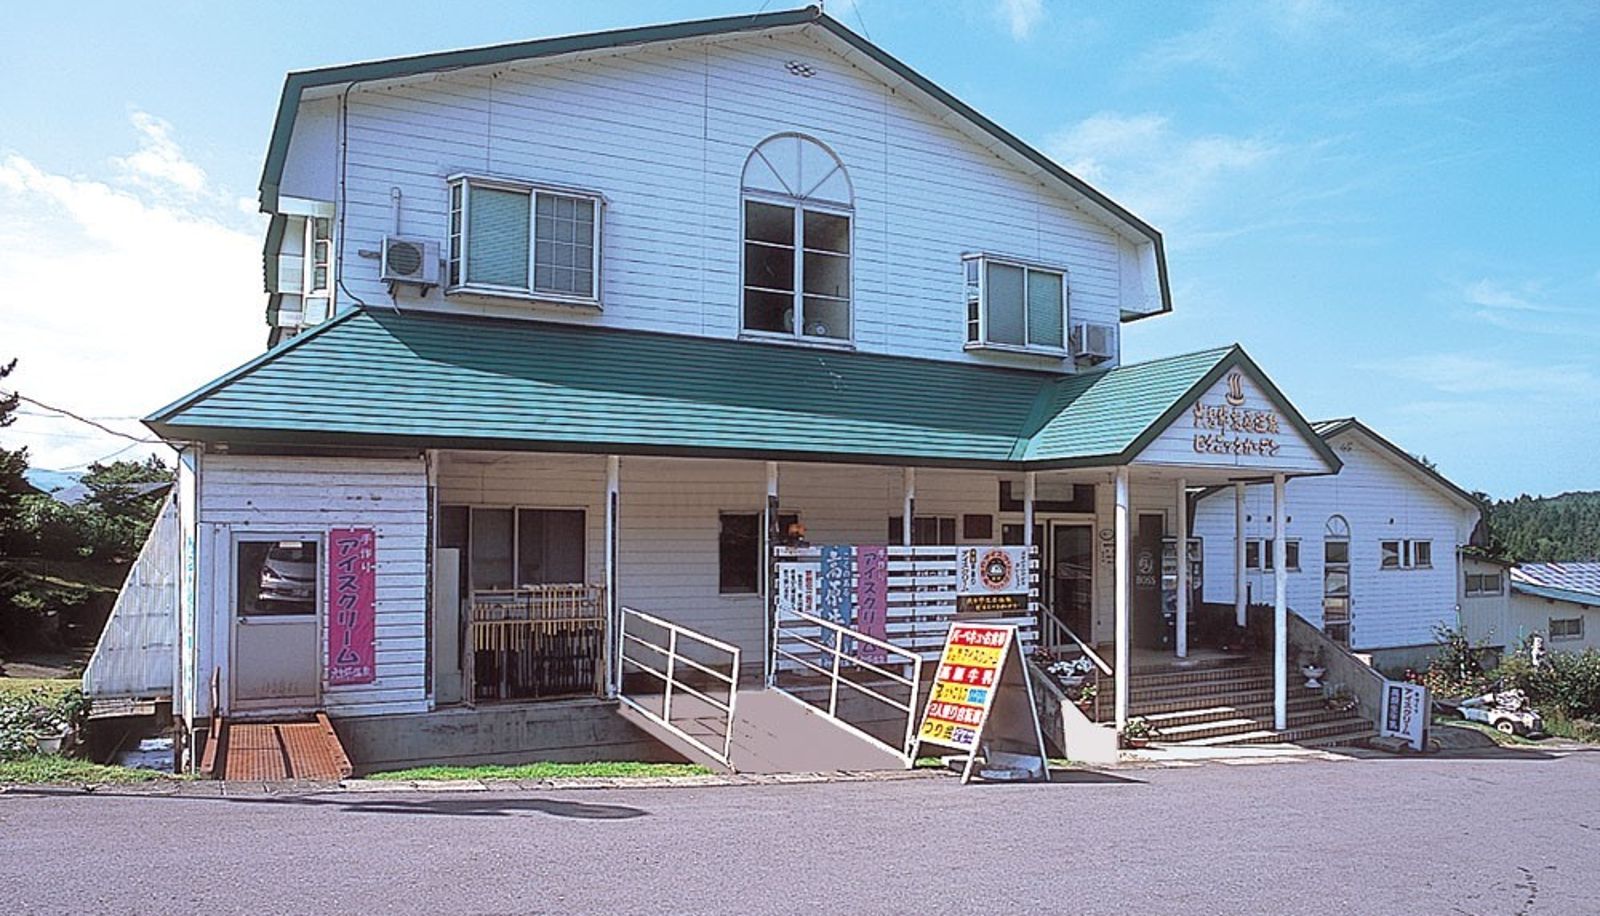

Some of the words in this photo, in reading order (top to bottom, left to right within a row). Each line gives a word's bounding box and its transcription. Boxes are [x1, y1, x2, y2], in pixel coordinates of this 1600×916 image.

[337, 537, 361, 666] アイスクリーム
[863, 552, 877, 653] アイスクリーム
[939, 665, 995, 685] 高原牛乳
